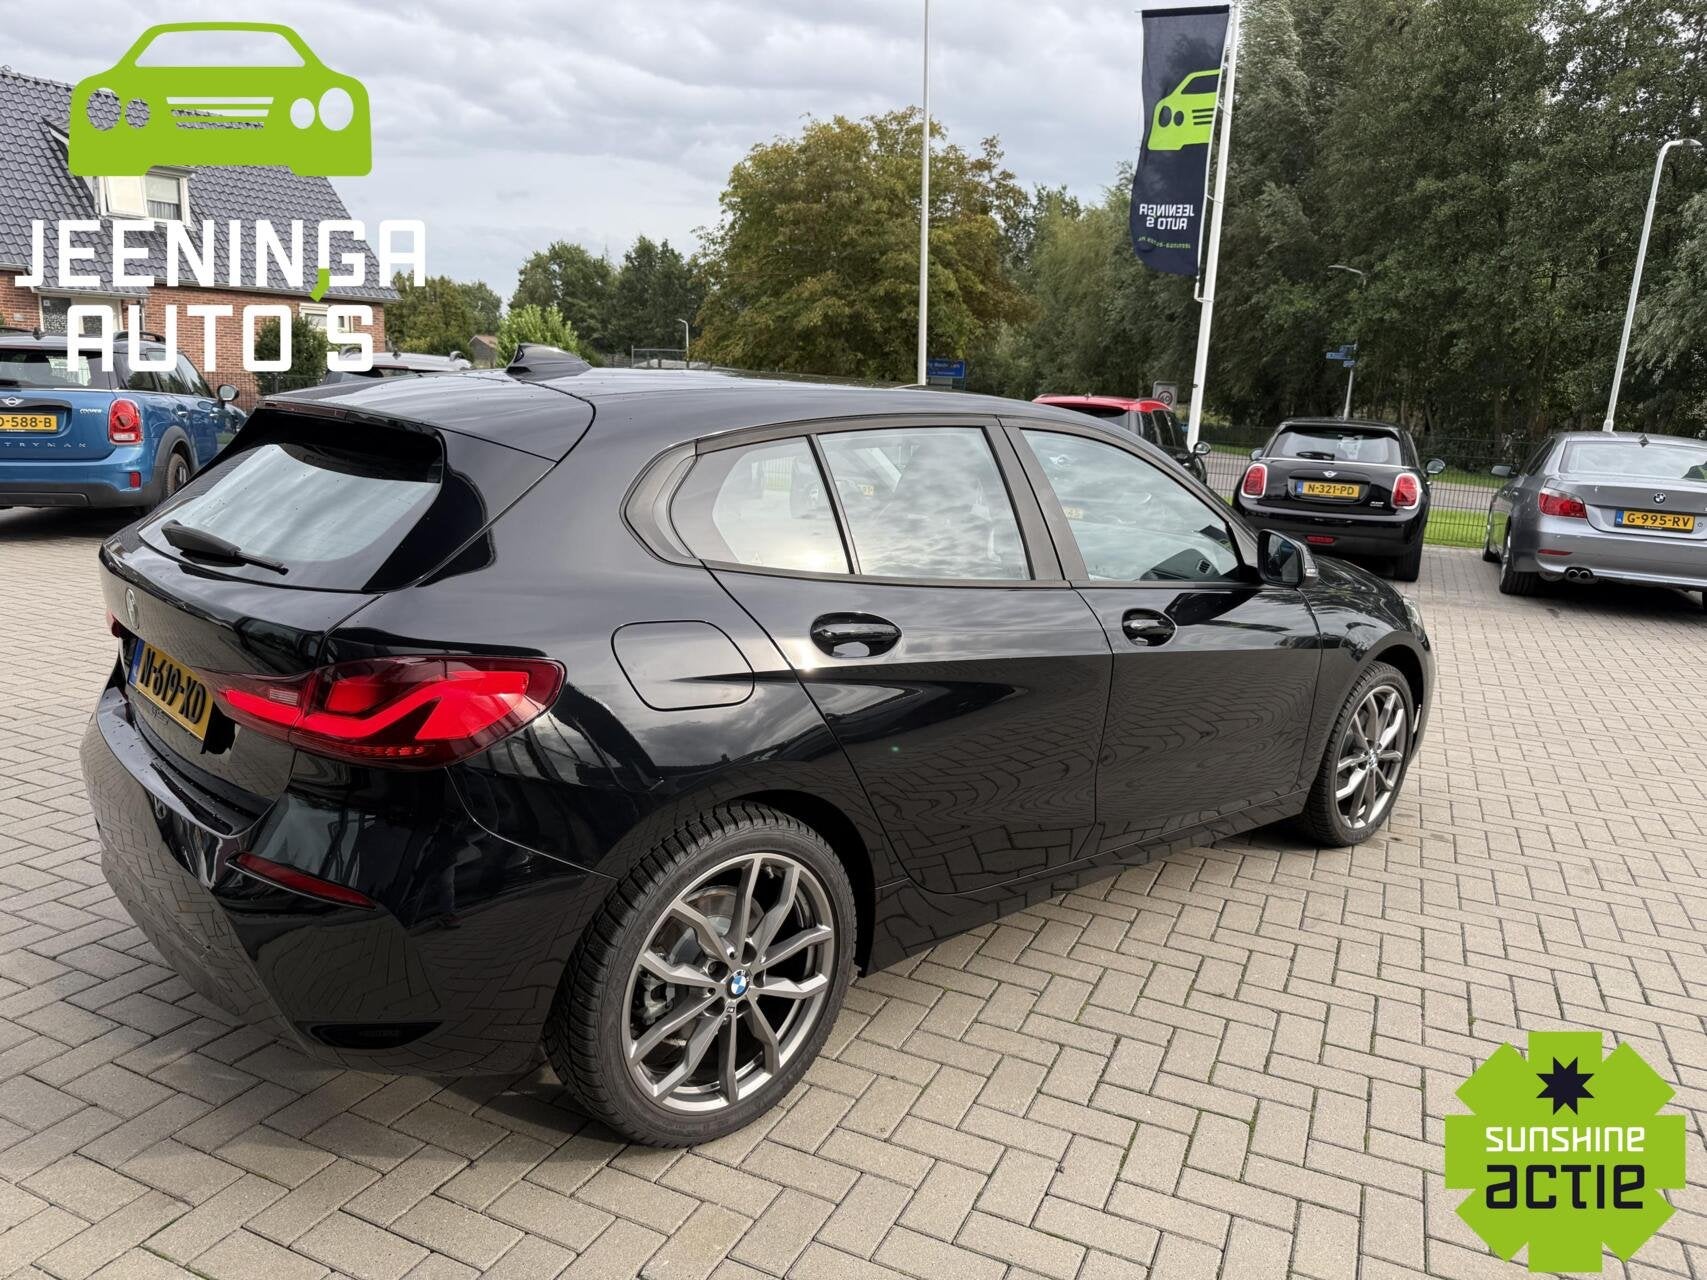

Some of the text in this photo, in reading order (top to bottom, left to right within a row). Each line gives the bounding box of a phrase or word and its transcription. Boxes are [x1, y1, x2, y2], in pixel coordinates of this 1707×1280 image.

[1308, 484, 1355, 495] N-321-PD
[1627, 513, 1690, 527] G-995-RV
[139, 647, 207, 725] N-619-XD
